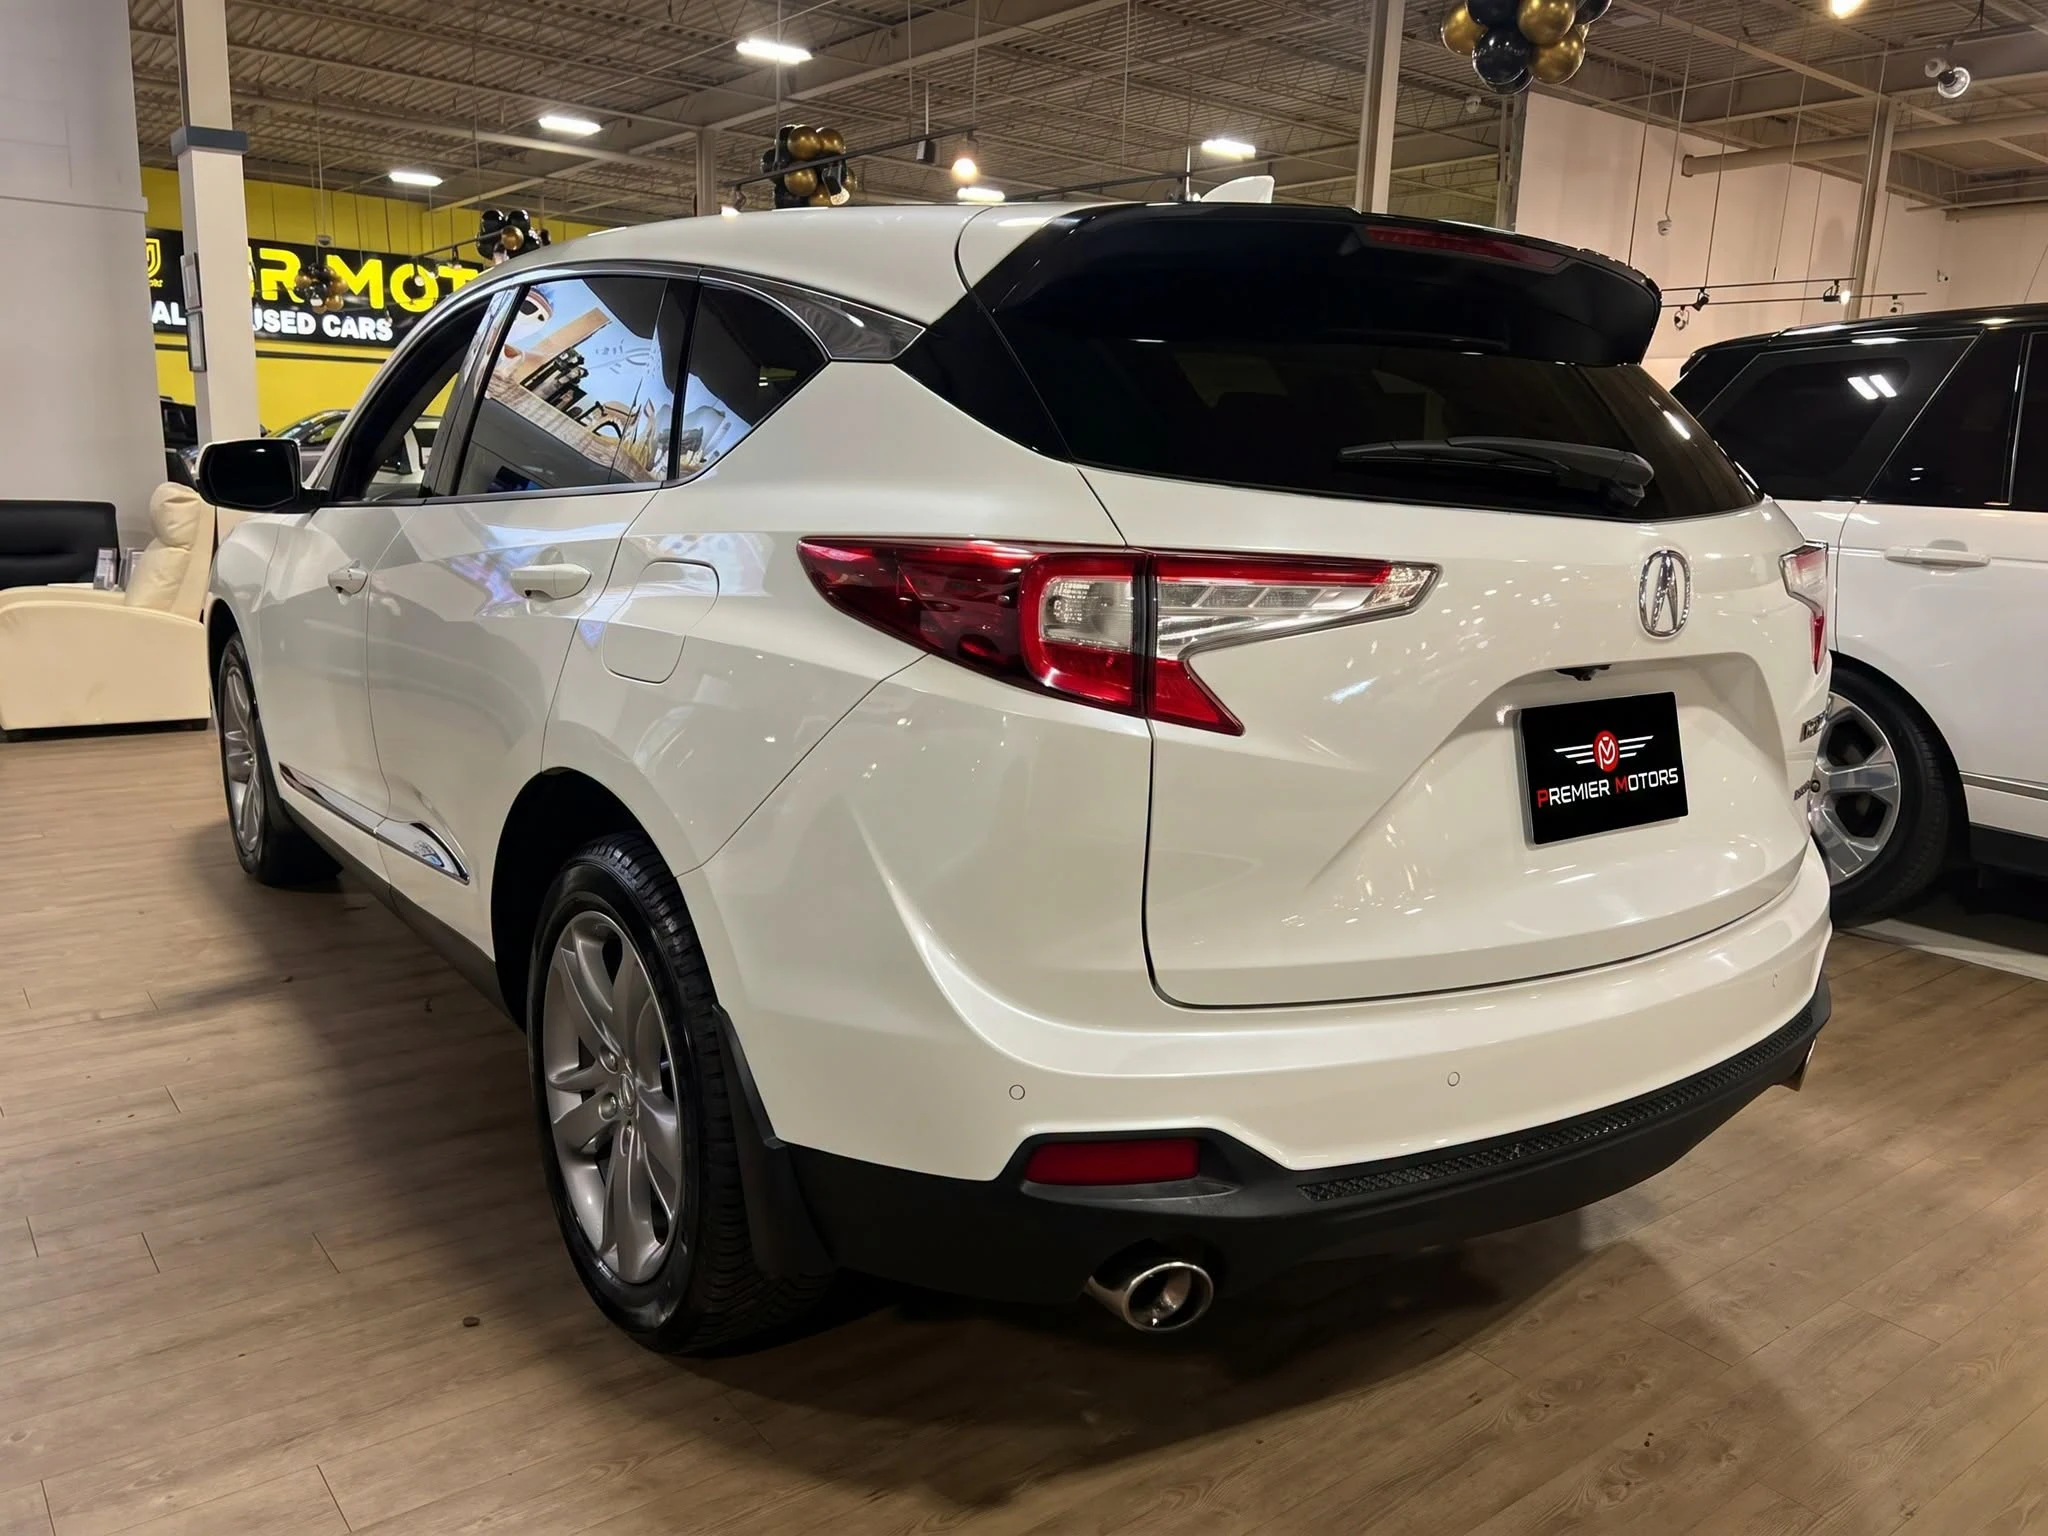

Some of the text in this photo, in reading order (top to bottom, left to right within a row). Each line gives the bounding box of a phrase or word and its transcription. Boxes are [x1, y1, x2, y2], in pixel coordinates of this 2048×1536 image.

[322, 314, 394, 342] CARS
[1536, 767, 1679, 808] PREMIER MOTORS
